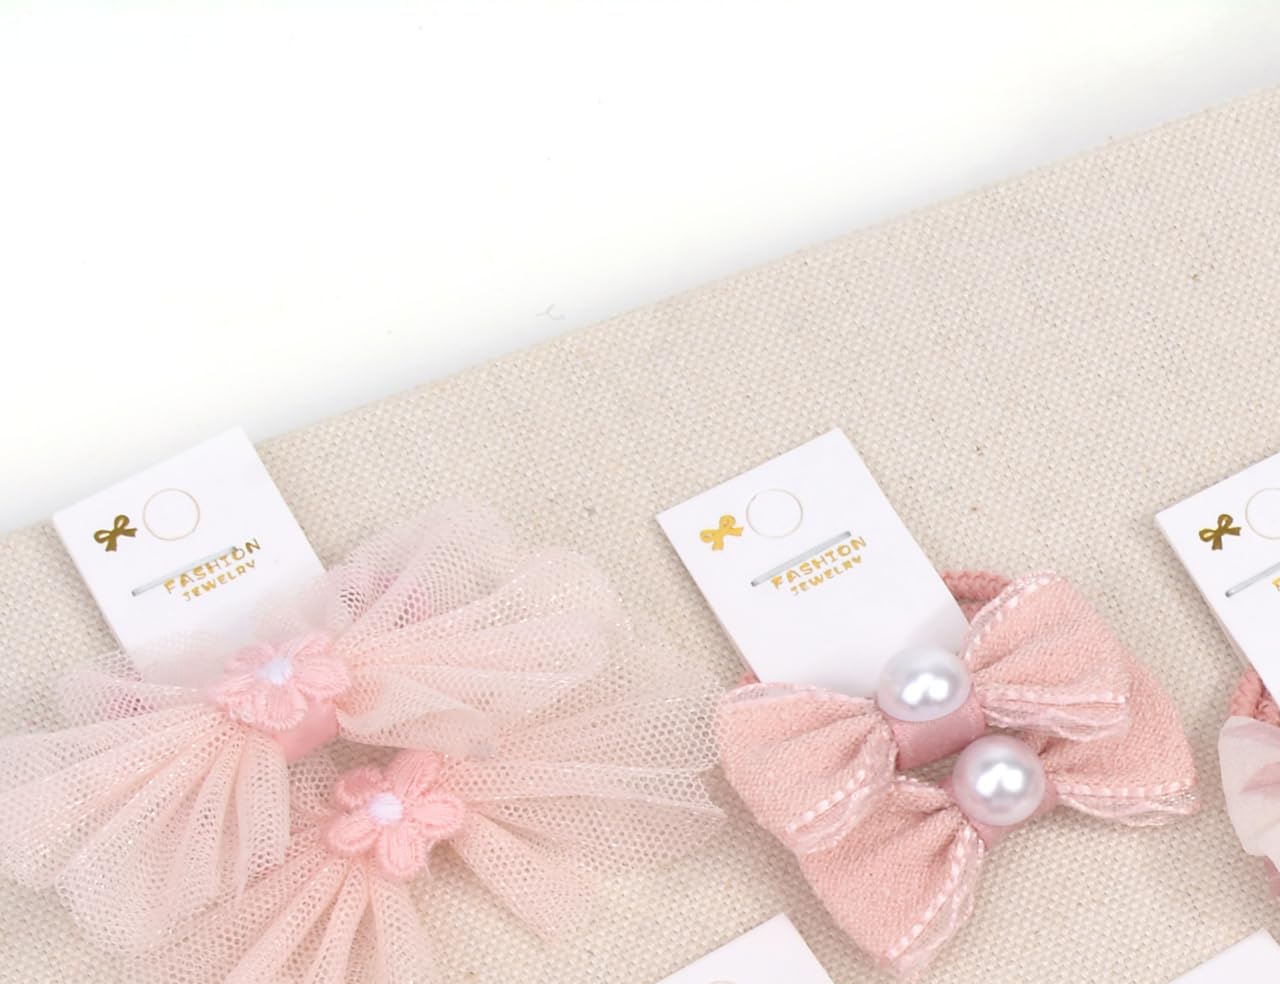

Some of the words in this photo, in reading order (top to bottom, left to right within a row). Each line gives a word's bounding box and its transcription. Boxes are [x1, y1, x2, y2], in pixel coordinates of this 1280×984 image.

[164, 538, 260, 595] FASHION
[182, 559, 255, 602] JEWELRY
[771, 536, 866, 589] FASHION
[790, 555, 861, 596] JEWELRY
